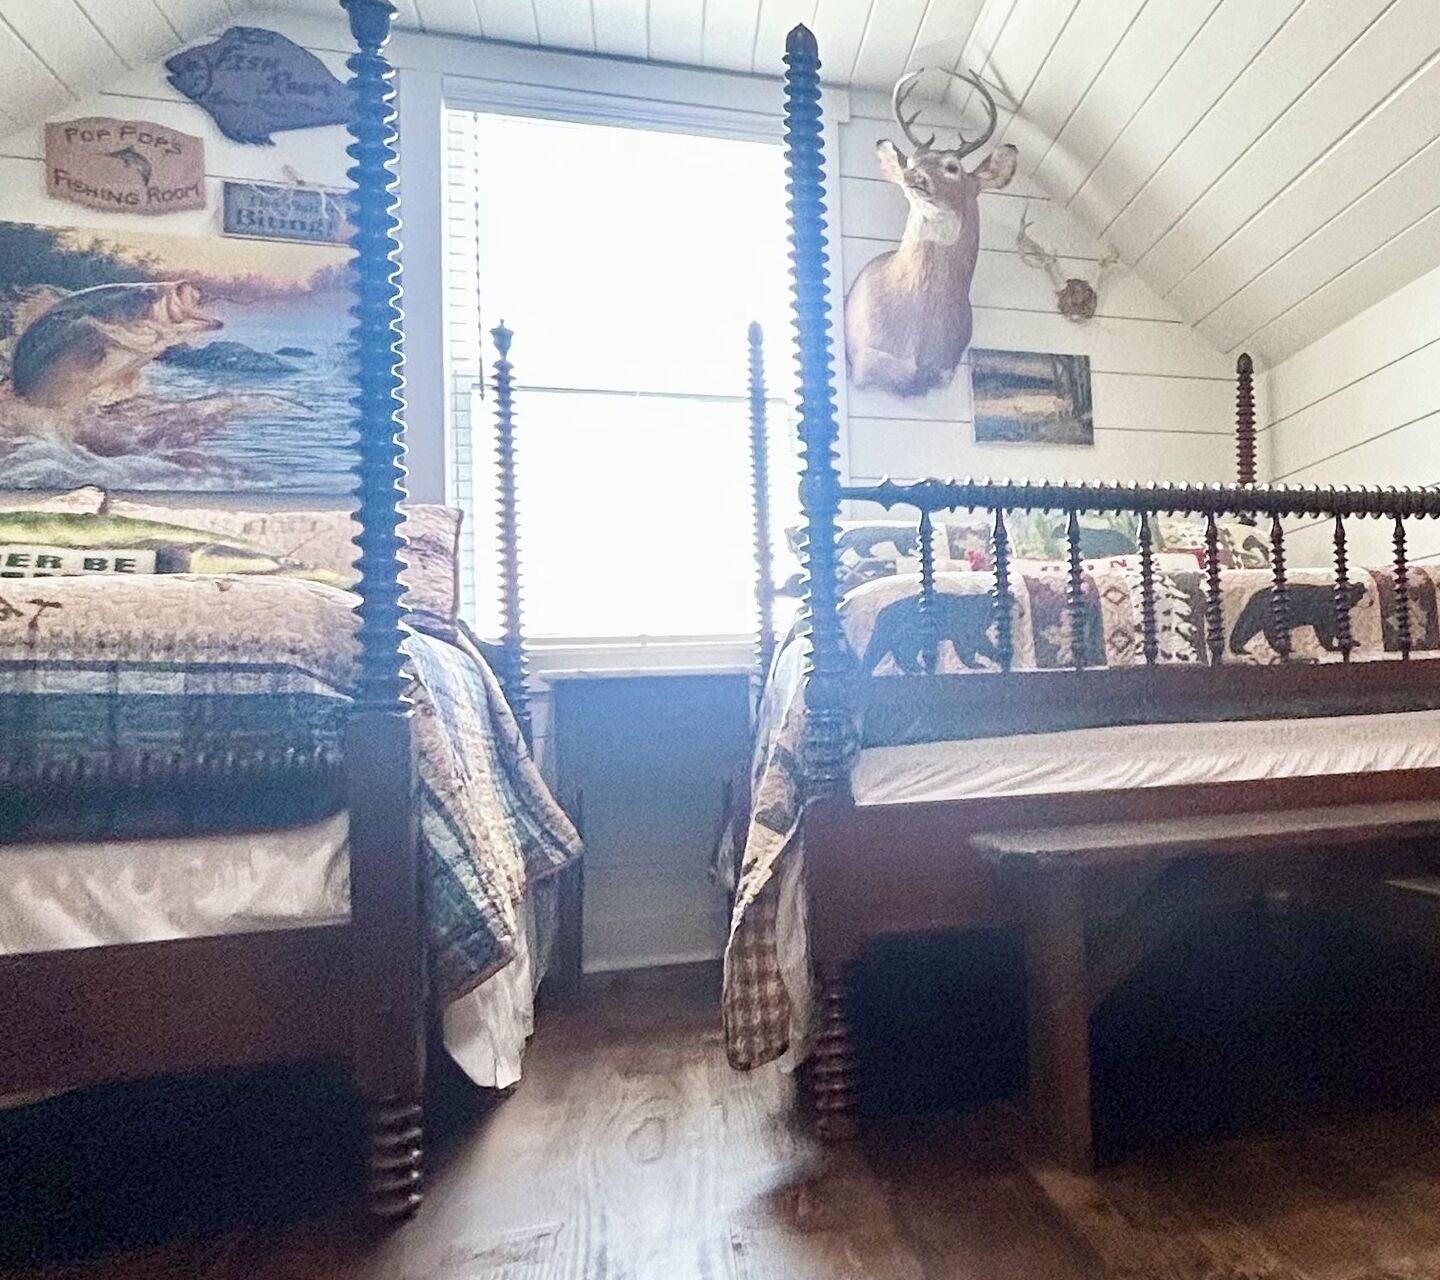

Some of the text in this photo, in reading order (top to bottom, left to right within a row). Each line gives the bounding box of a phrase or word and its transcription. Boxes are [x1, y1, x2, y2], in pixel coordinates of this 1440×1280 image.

[64, 127, 111, 143] POP
[53, 168, 200, 206] FISHING ROOM
[0, 553, 137, 573] ER BE
